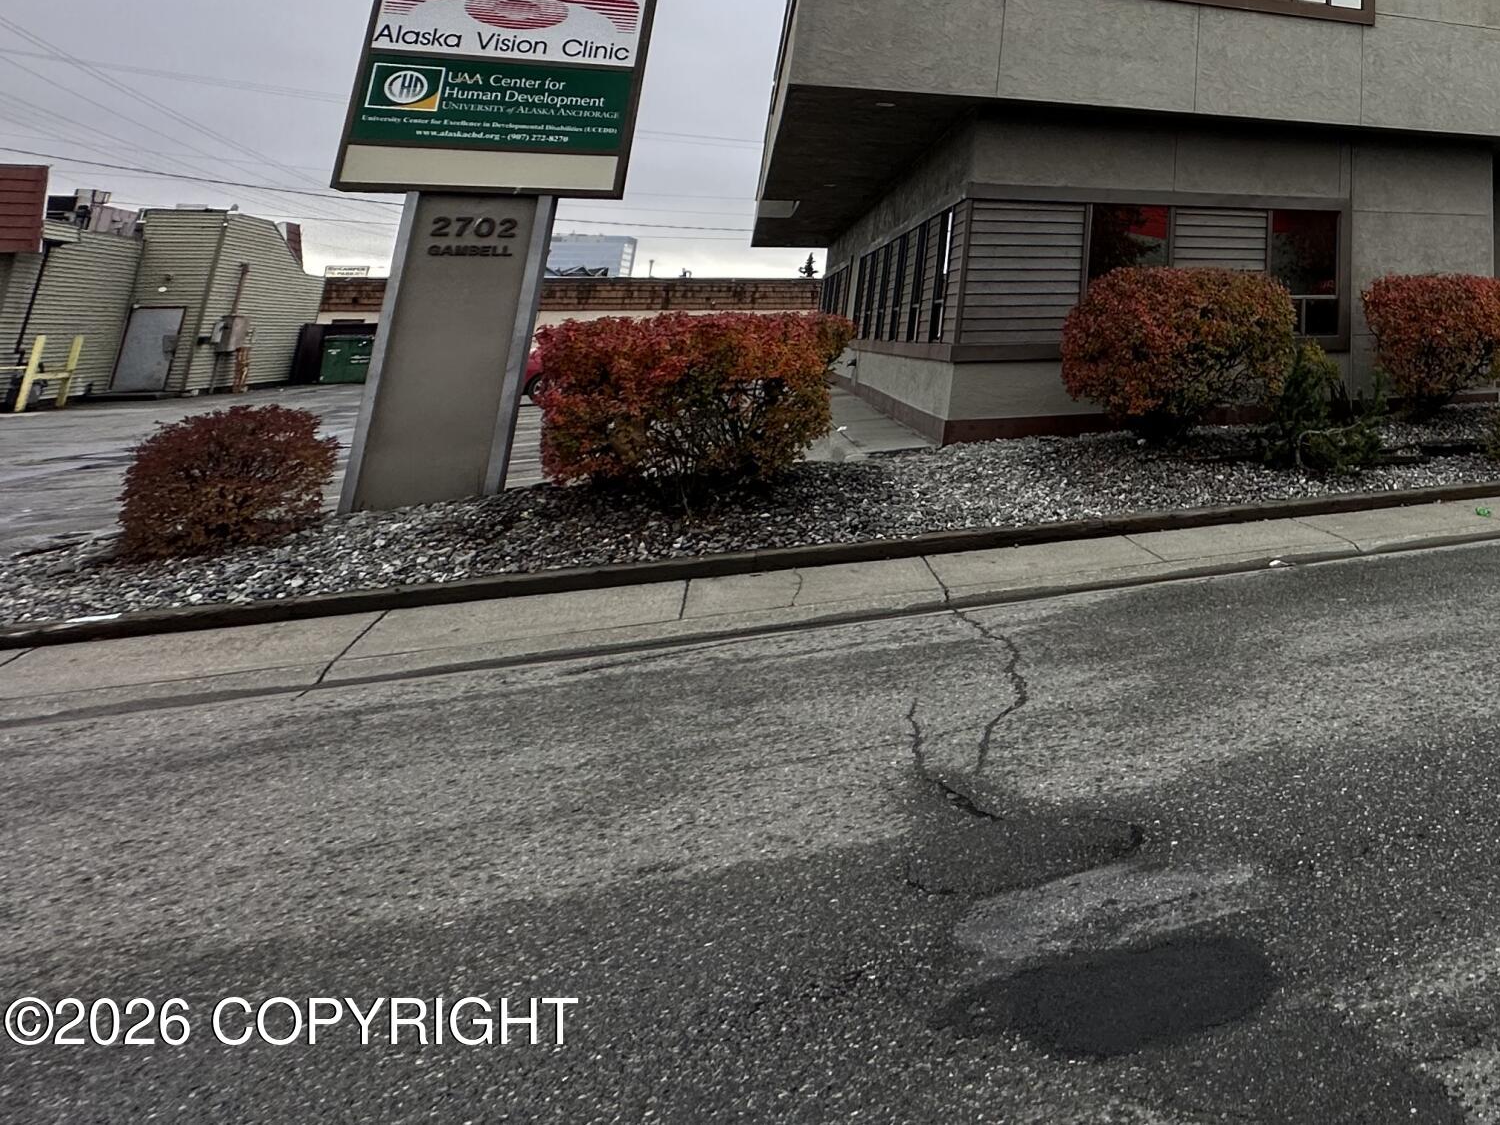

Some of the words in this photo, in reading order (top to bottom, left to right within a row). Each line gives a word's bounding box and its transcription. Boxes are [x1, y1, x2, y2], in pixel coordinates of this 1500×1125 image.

[373, 24, 462, 49] Alaska
[477, 31, 547, 55] Vision
[562, 39, 630, 61] Clinic
[448, 71, 483, 85] UAA
[489, 74, 541, 90] Center
[544, 77, 566, 91] for
[444, 86, 501, 101] Human
[505, 90, 605, 108] Development
[361, 114, 401, 123] University
[403, 116, 429, 125] Center
[442, 100, 506, 114] UNIVERSITY
[506, 106, 515, 114] of
[516, 105, 555, 117] ALASKA
[556, 108, 620, 120] ANCHORAGE
[415, 129, 500, 141] www.alaskachd.org
[507, 133, 529, 142] (907)
[430, 216, 518, 238] 2702
[427, 244, 513, 257] GAMBELL
